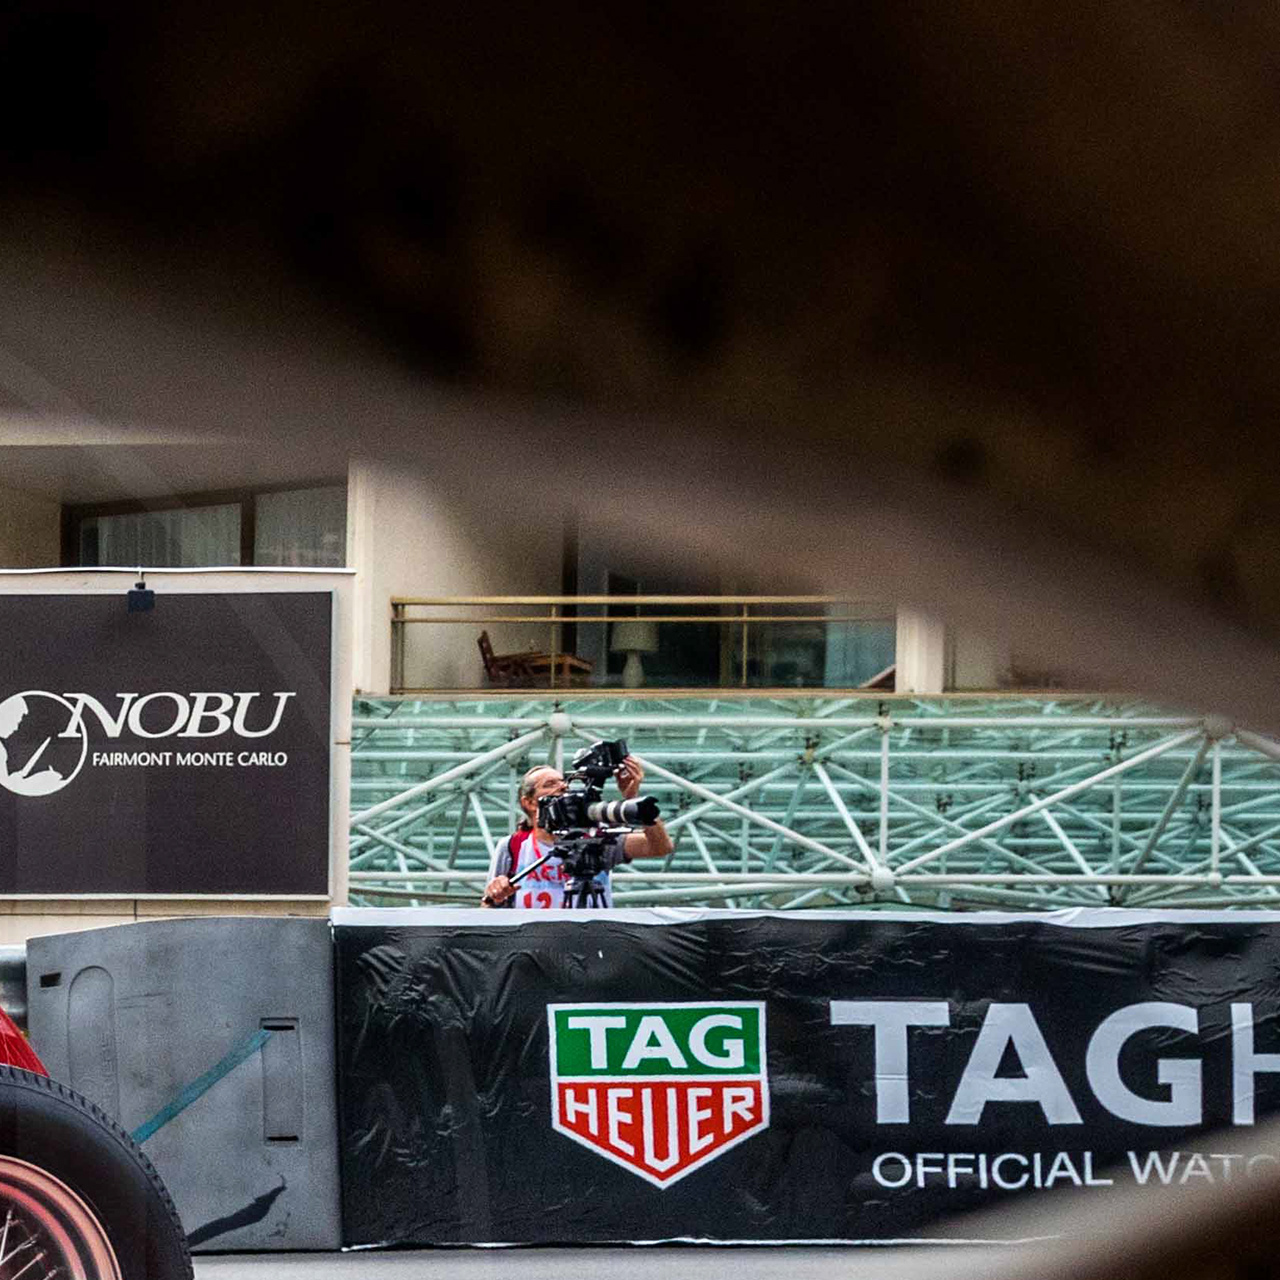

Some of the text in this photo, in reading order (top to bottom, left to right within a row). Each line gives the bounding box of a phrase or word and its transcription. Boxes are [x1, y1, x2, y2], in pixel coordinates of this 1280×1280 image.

[58, 691, 296, 739] NOBU
[92, 751, 288, 767] FAIRMONT MONTE CARLO
[568, 1013, 746, 1070] TAG
[564, 1086, 755, 1173] HEUER
[871, 1151, 1114, 1190] OFFICIAL
